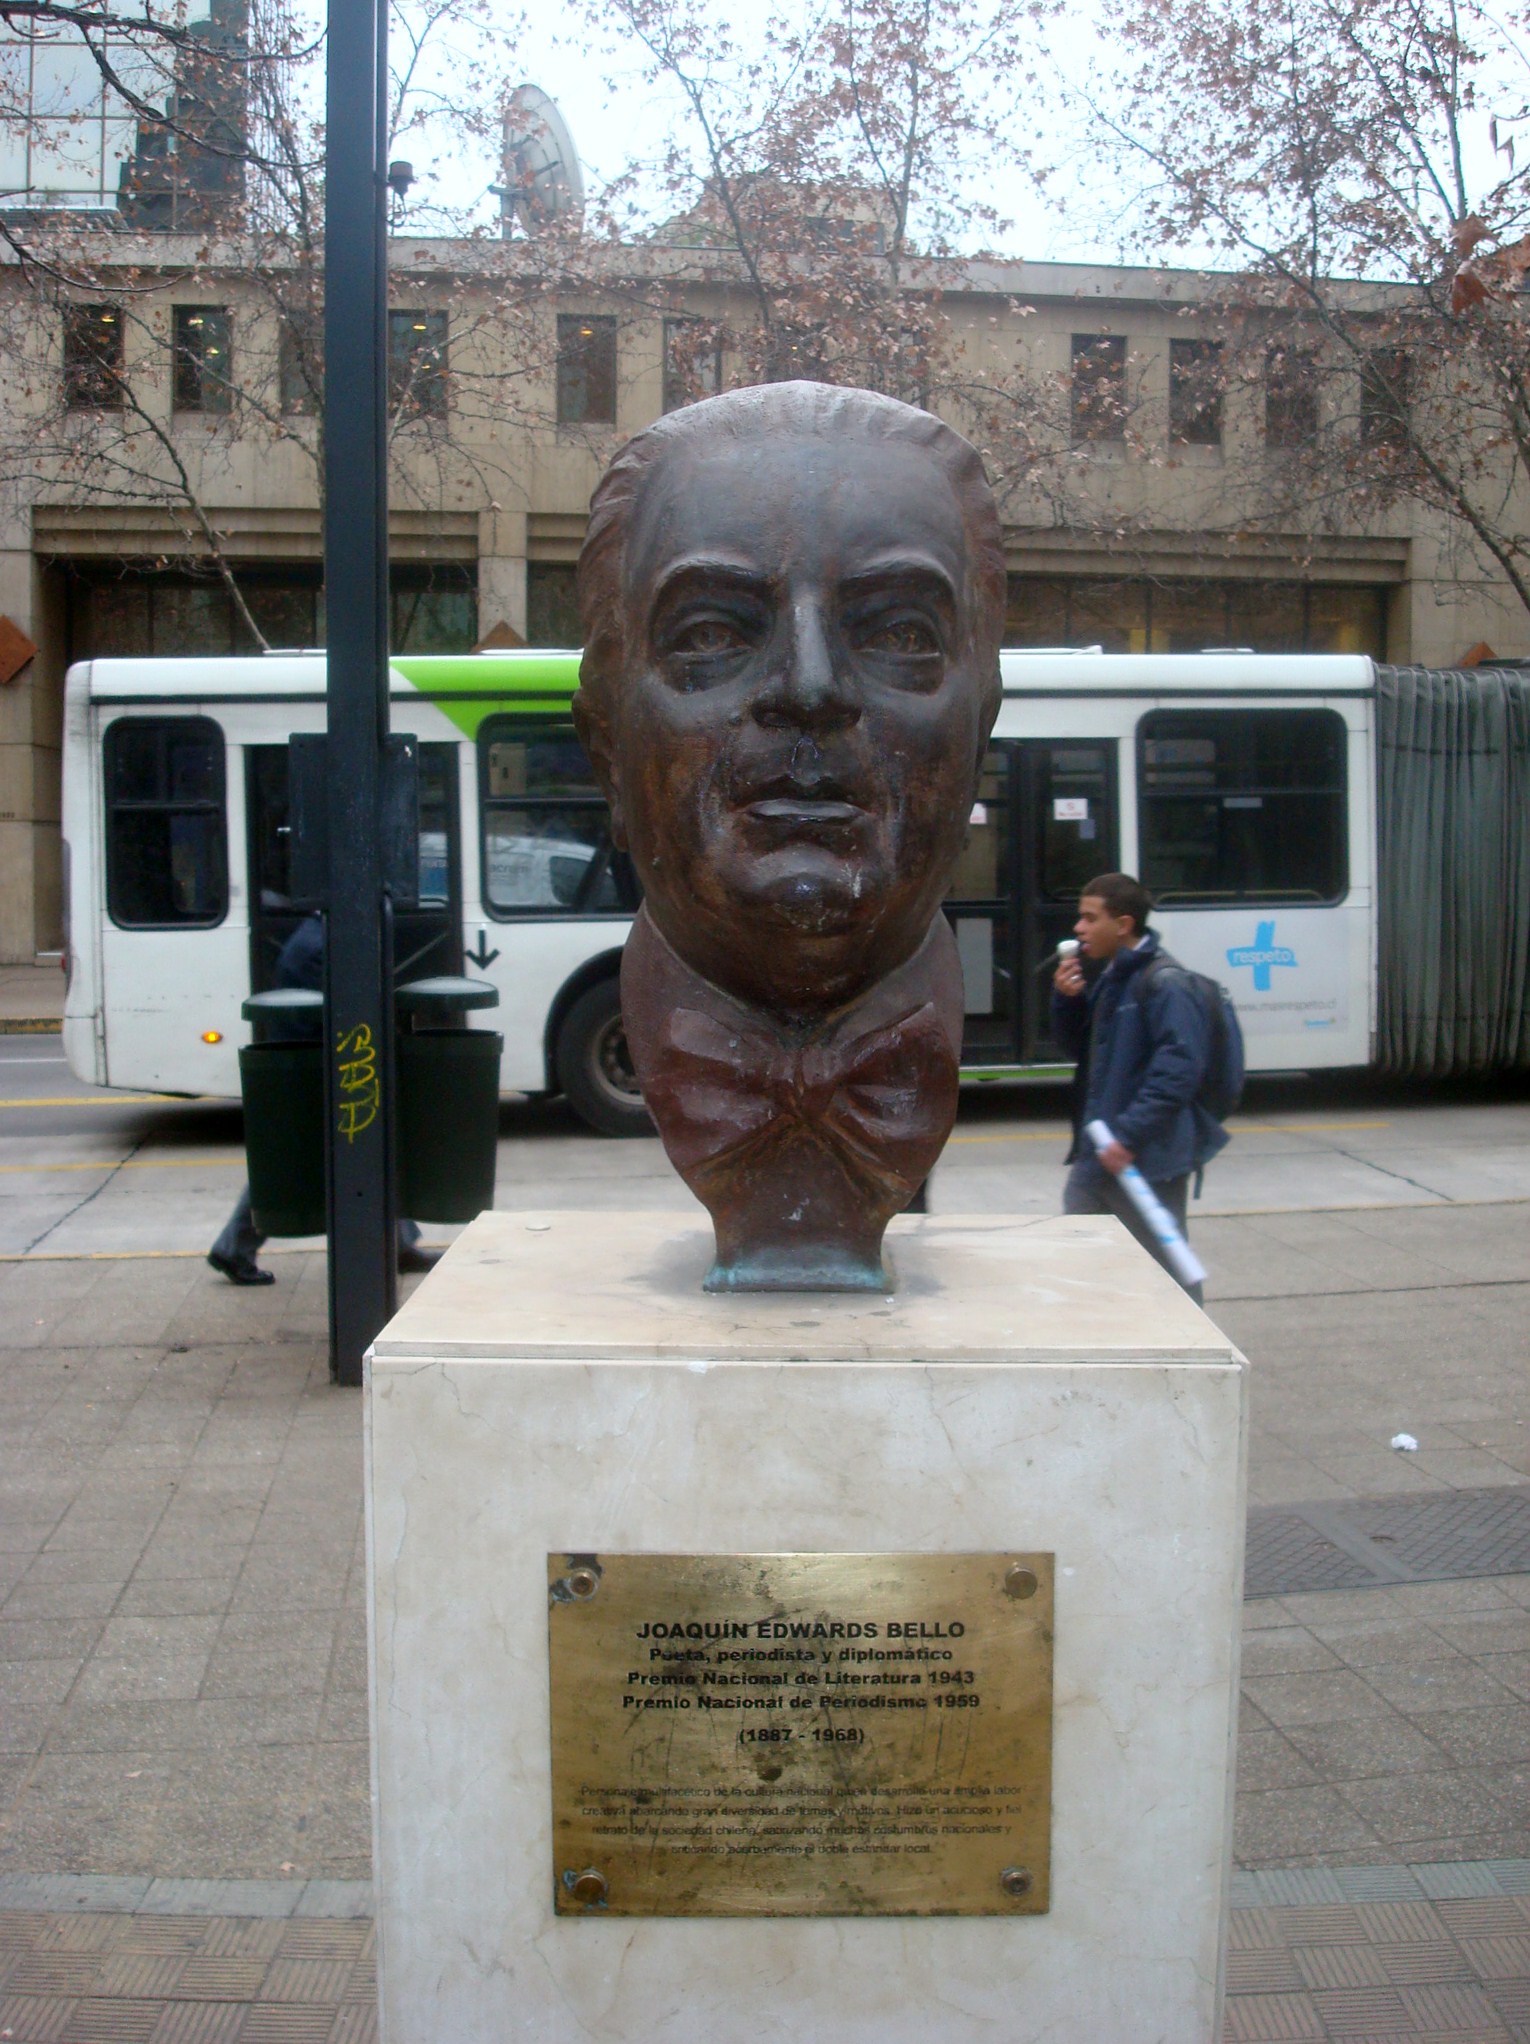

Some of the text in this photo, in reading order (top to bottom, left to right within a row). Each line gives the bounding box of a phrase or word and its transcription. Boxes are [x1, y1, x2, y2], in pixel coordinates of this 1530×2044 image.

[636, 1620, 966, 1640] JOAQUÍN EDWARDS BELLO
[821, 1651, 832, 1664] y
[838, 1647, 953, 1664] diplomático
[628, 1671, 975, 1685] Premio Nacional de Literatura 1943
[622, 1695, 981, 1709] Premio Nacional de Periodismo 1959
[739, 1728, 793, 1745] (1887
[811, 1728, 865, 1744] 1968)
[713, 1786, 728, 1796] de
[744, 1786, 783, 1796] cultura
[786, 1785, 833, 1796] nacional
[629, 1805, 689, 1816] abarcando
[692, 1807, 718, 1818] gran
[721, 1806, 778, 1816] diversidad
[781, 1806, 796, 1816] de
[896, 1805, 923, 1815] Hizo
[630, 1825, 646, 1835] de
[662, 1825, 712, 1835] sociedad
[826, 1825, 871, 1835] muchas
[941, 1824, 1002, 1834] nacionales
